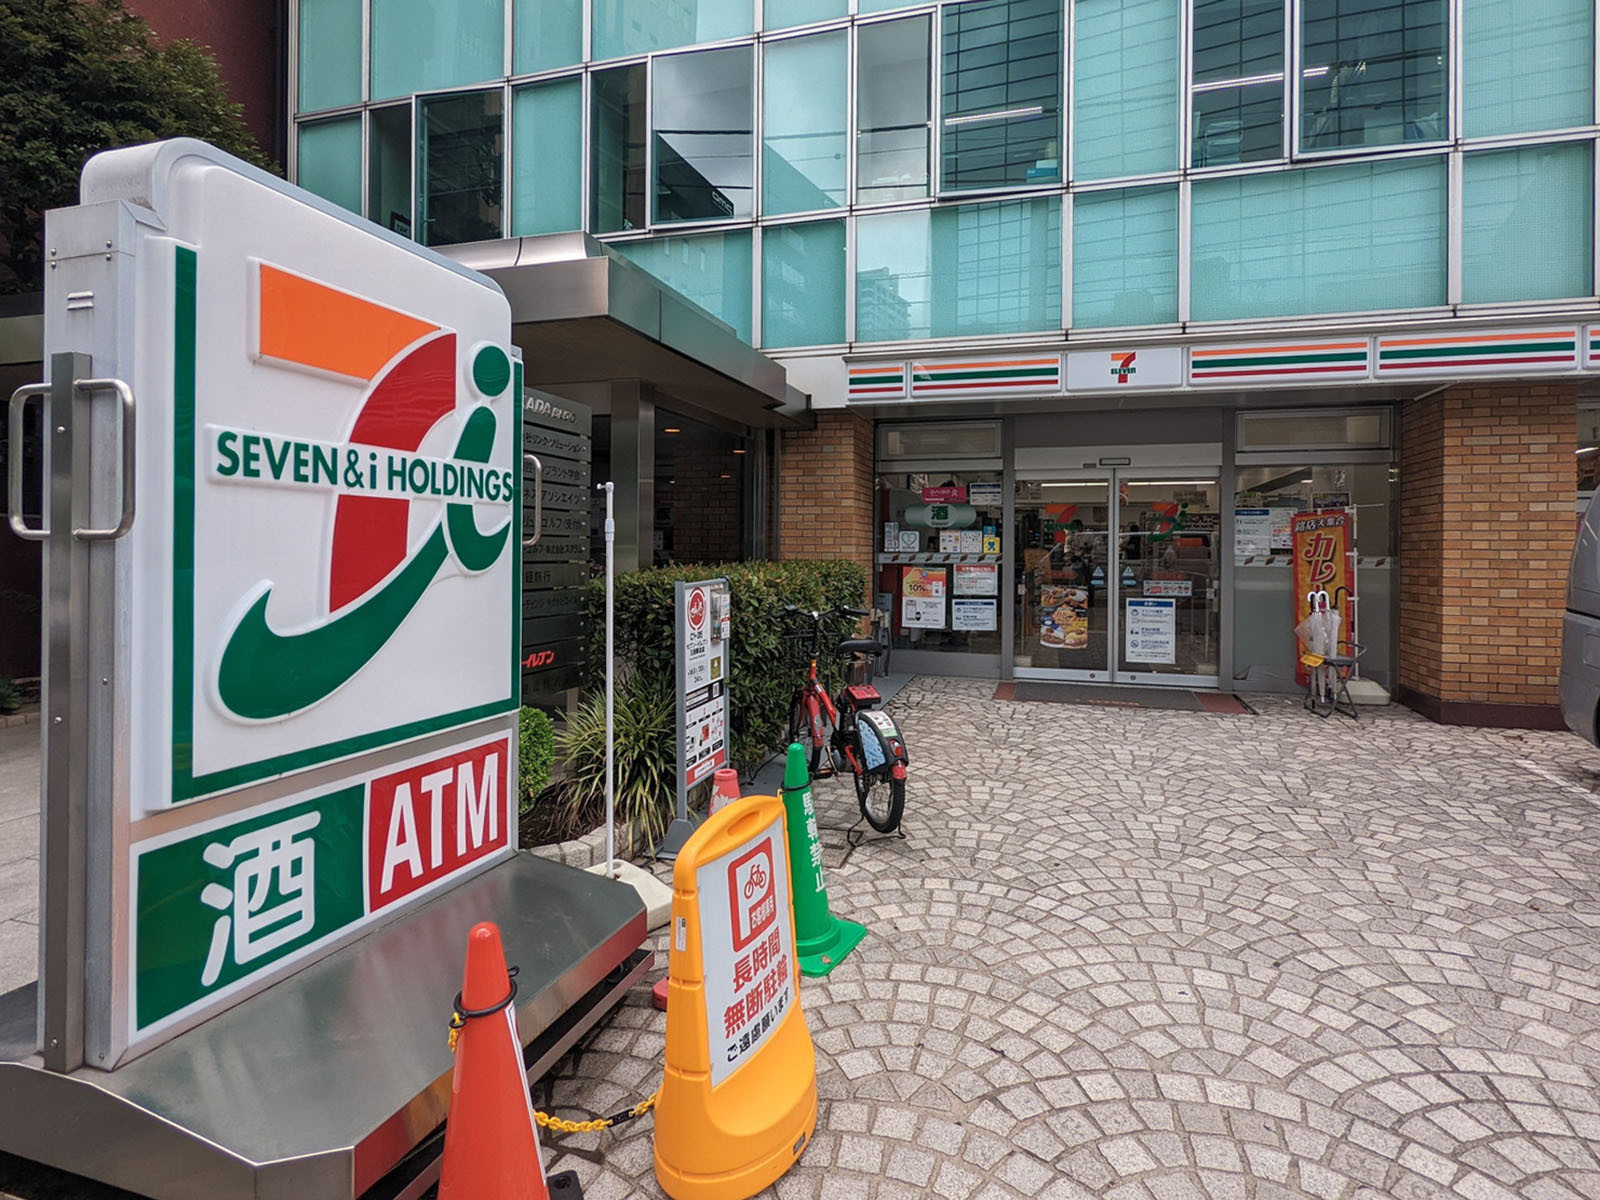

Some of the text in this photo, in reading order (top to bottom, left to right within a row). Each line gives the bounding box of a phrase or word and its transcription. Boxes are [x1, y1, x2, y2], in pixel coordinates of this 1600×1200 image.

[387, 454, 513, 503] HOLDINGS
[931, 505, 949, 520] 酒
[380, 752, 499, 895] ATM
[200, 810, 321, 987] 酒
[723, 953, 788, 1039] 無断駐輪
[732, 926, 780, 994] 長時間
[727, 986, 789, 1062] ご遠慮願います
